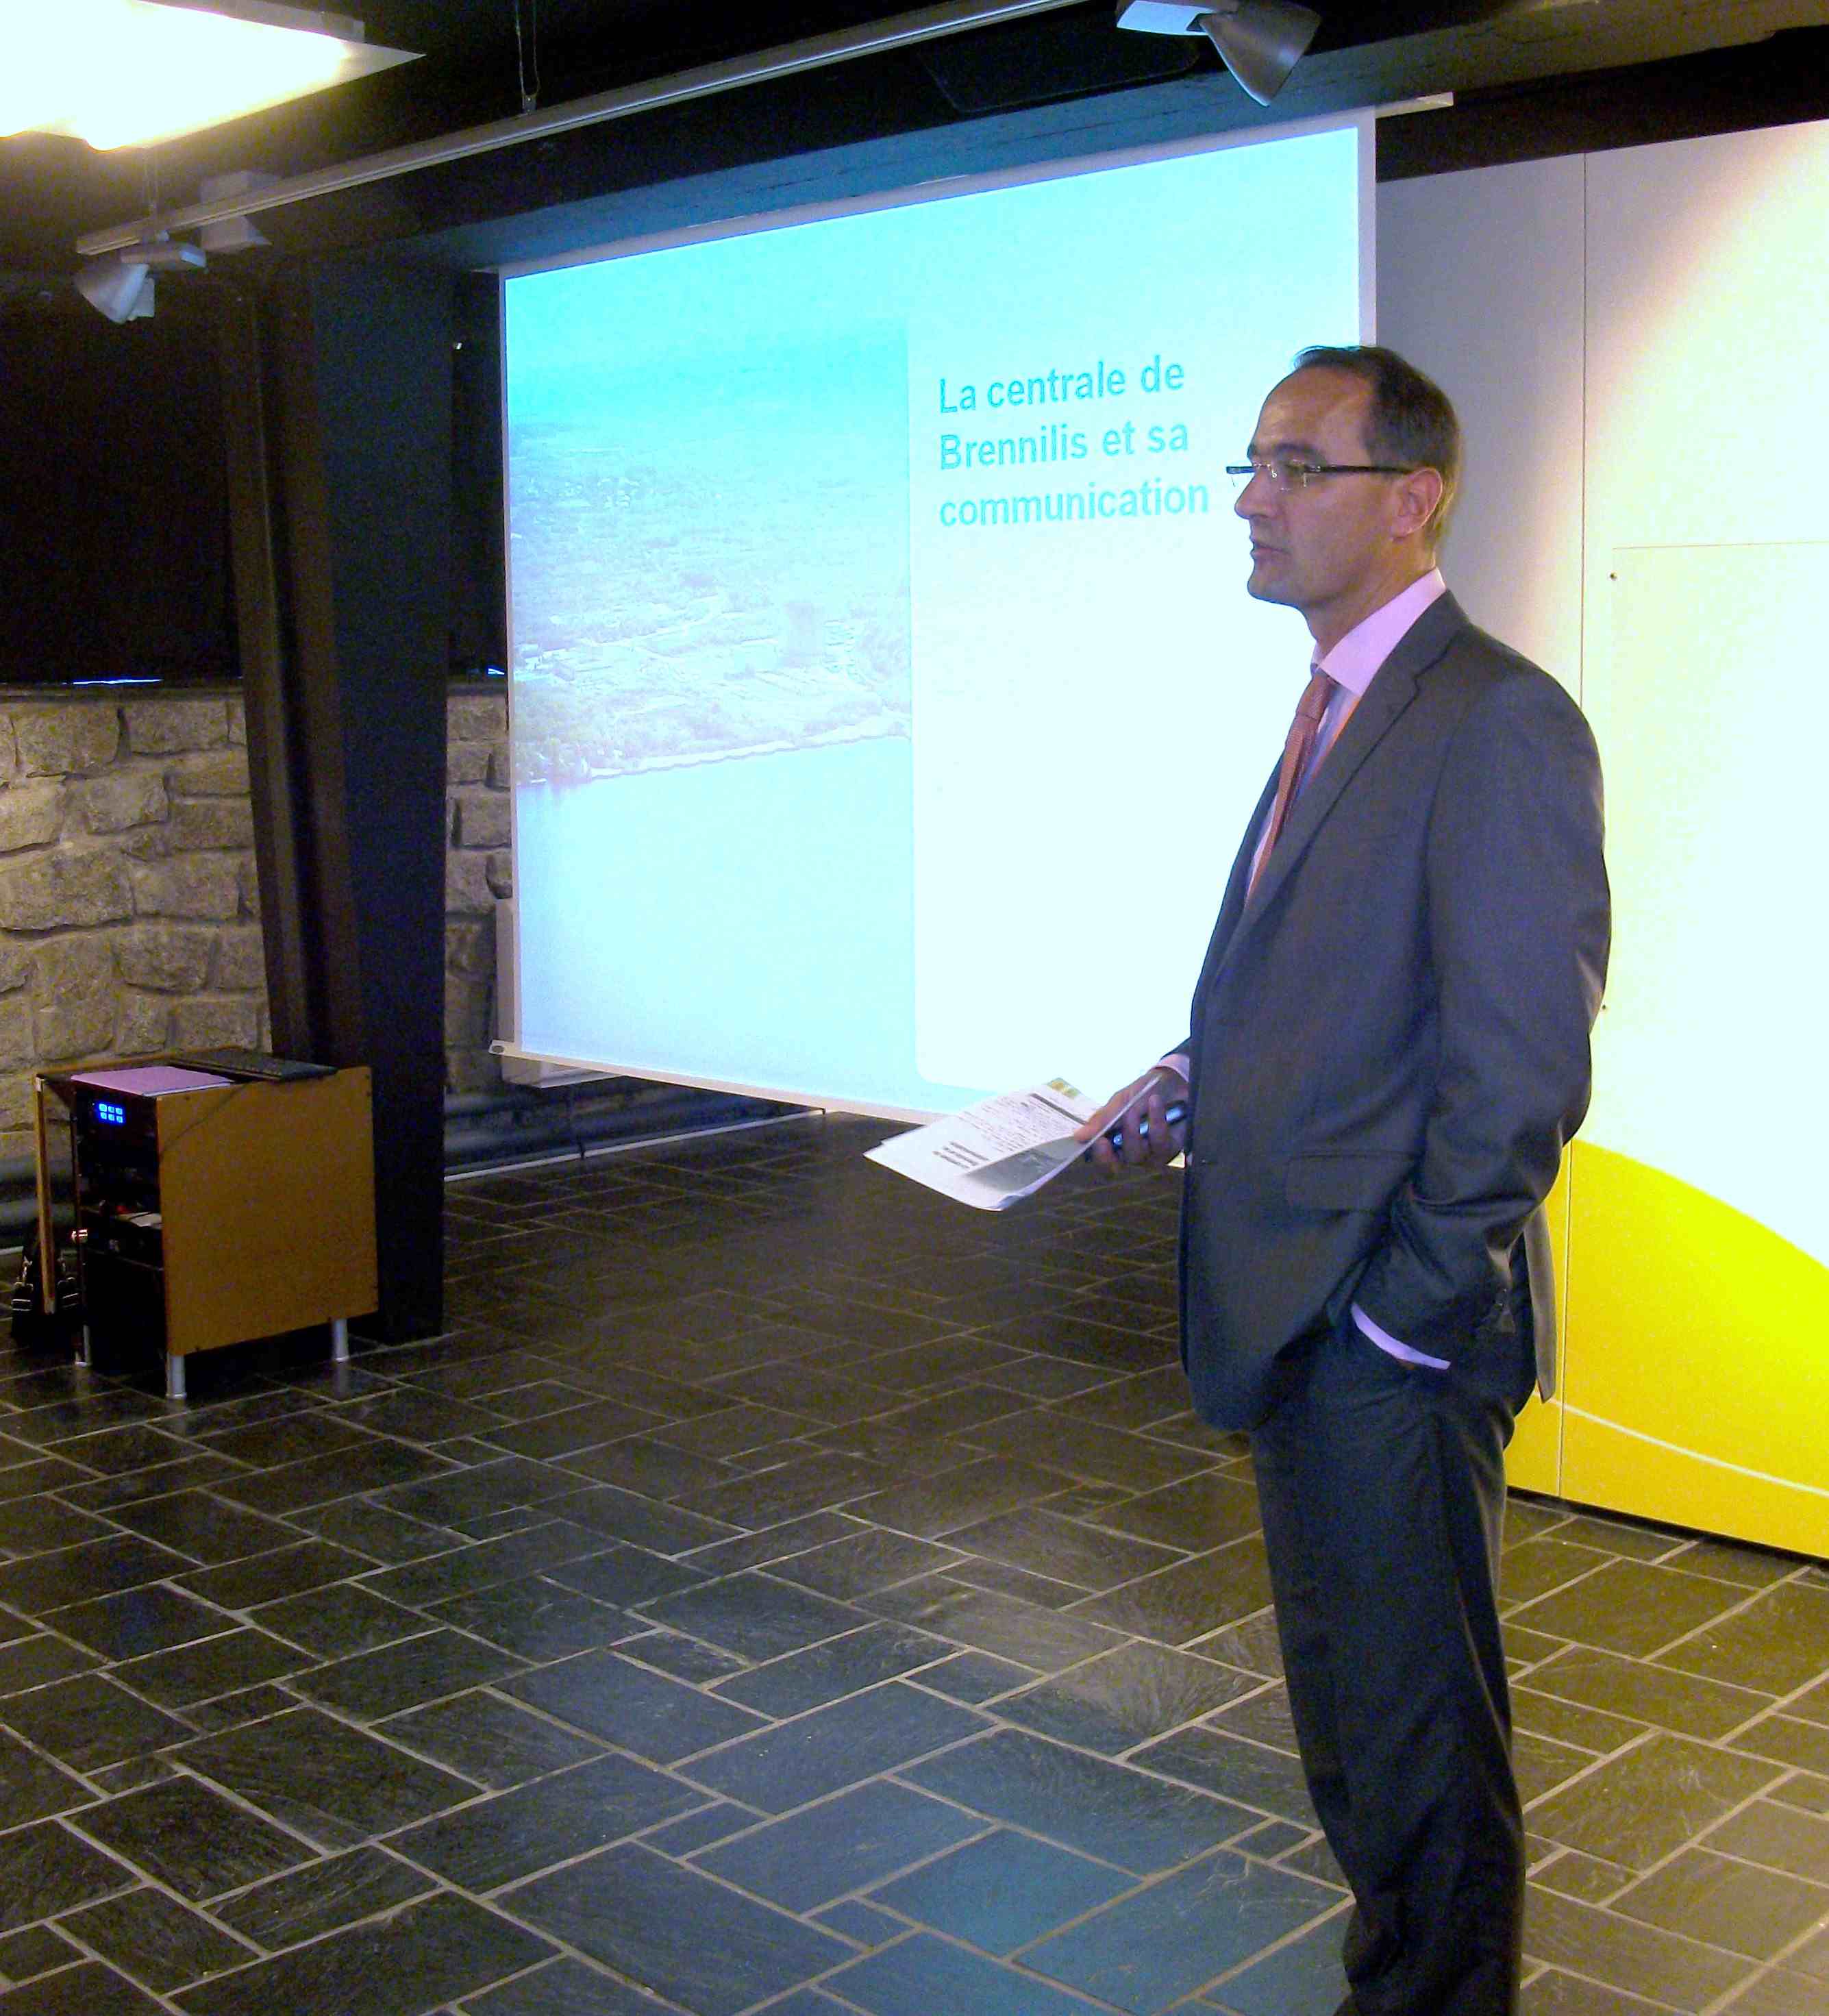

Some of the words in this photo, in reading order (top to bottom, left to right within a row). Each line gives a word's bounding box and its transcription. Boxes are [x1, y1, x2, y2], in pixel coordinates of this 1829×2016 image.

[940, 378, 976, 414] La
[987, 360, 1126, 408] centrale
[1141, 354, 1184, 393] de
[941, 423, 1088, 469] Brennilis
[1102, 421, 1134, 456] et
[1147, 423, 1189, 453] sa
[938, 477, 1209, 527] communication
